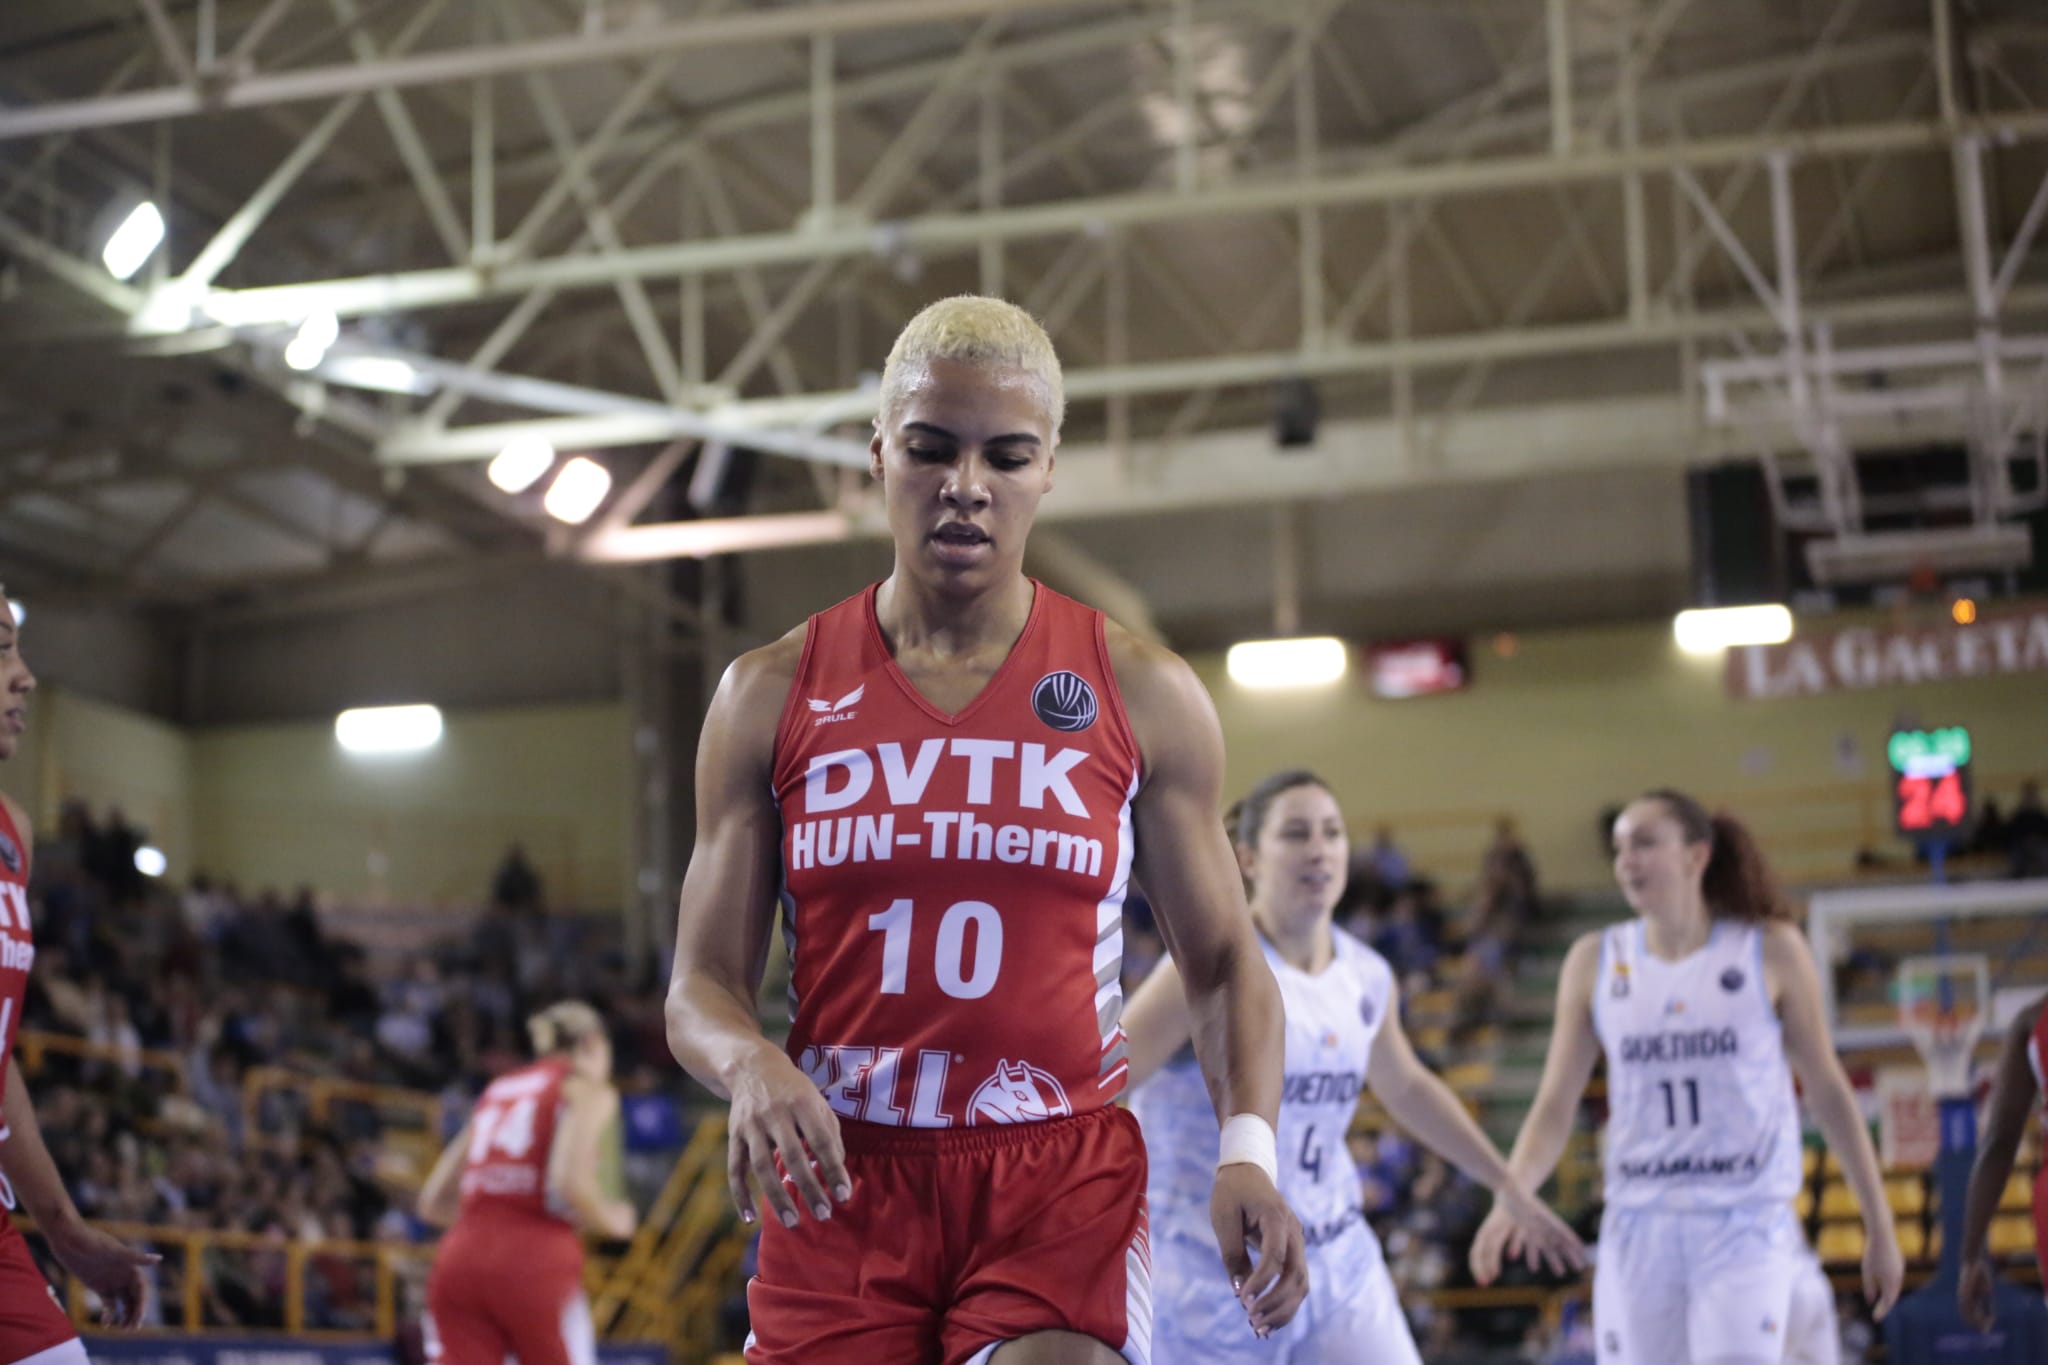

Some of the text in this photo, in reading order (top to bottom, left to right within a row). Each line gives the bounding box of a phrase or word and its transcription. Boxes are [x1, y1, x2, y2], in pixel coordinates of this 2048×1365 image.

[804, 738, 1091, 819] DVTK
[1898, 772, 1968, 829] 24
[792, 811, 1103, 877] HUN-Therm
[868, 898, 1003, 1000] 10
[467, 1095, 537, 1166] 14
[1657, 1077, 1700, 1128] 11
[1299, 1122, 1322, 1185] 4
